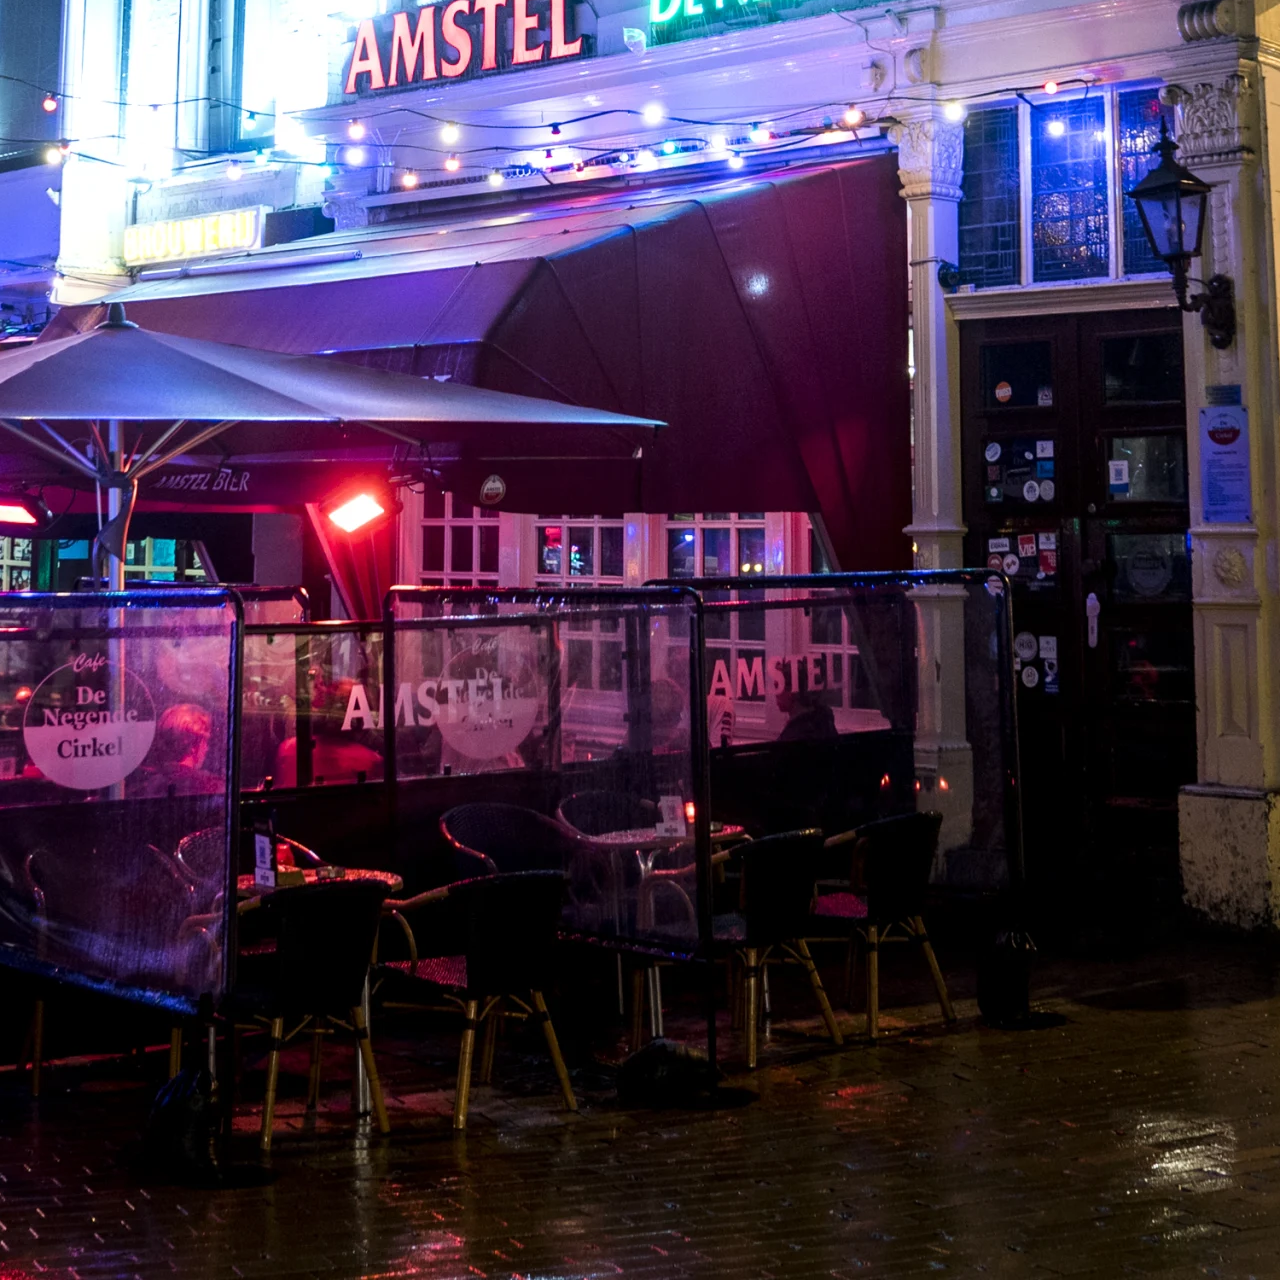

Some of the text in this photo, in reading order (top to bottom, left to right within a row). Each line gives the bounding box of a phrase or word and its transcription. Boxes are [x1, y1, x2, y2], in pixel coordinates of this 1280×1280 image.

[123, 210, 257, 263] BROUWERIJ
[149, 468, 250, 492] AMSTEL BIER
[708, 653, 843, 701] AMSTEL
[76, 686, 106, 705] De
[43, 707, 138, 731] Negende
[57, 736, 123, 759] Cirkel
